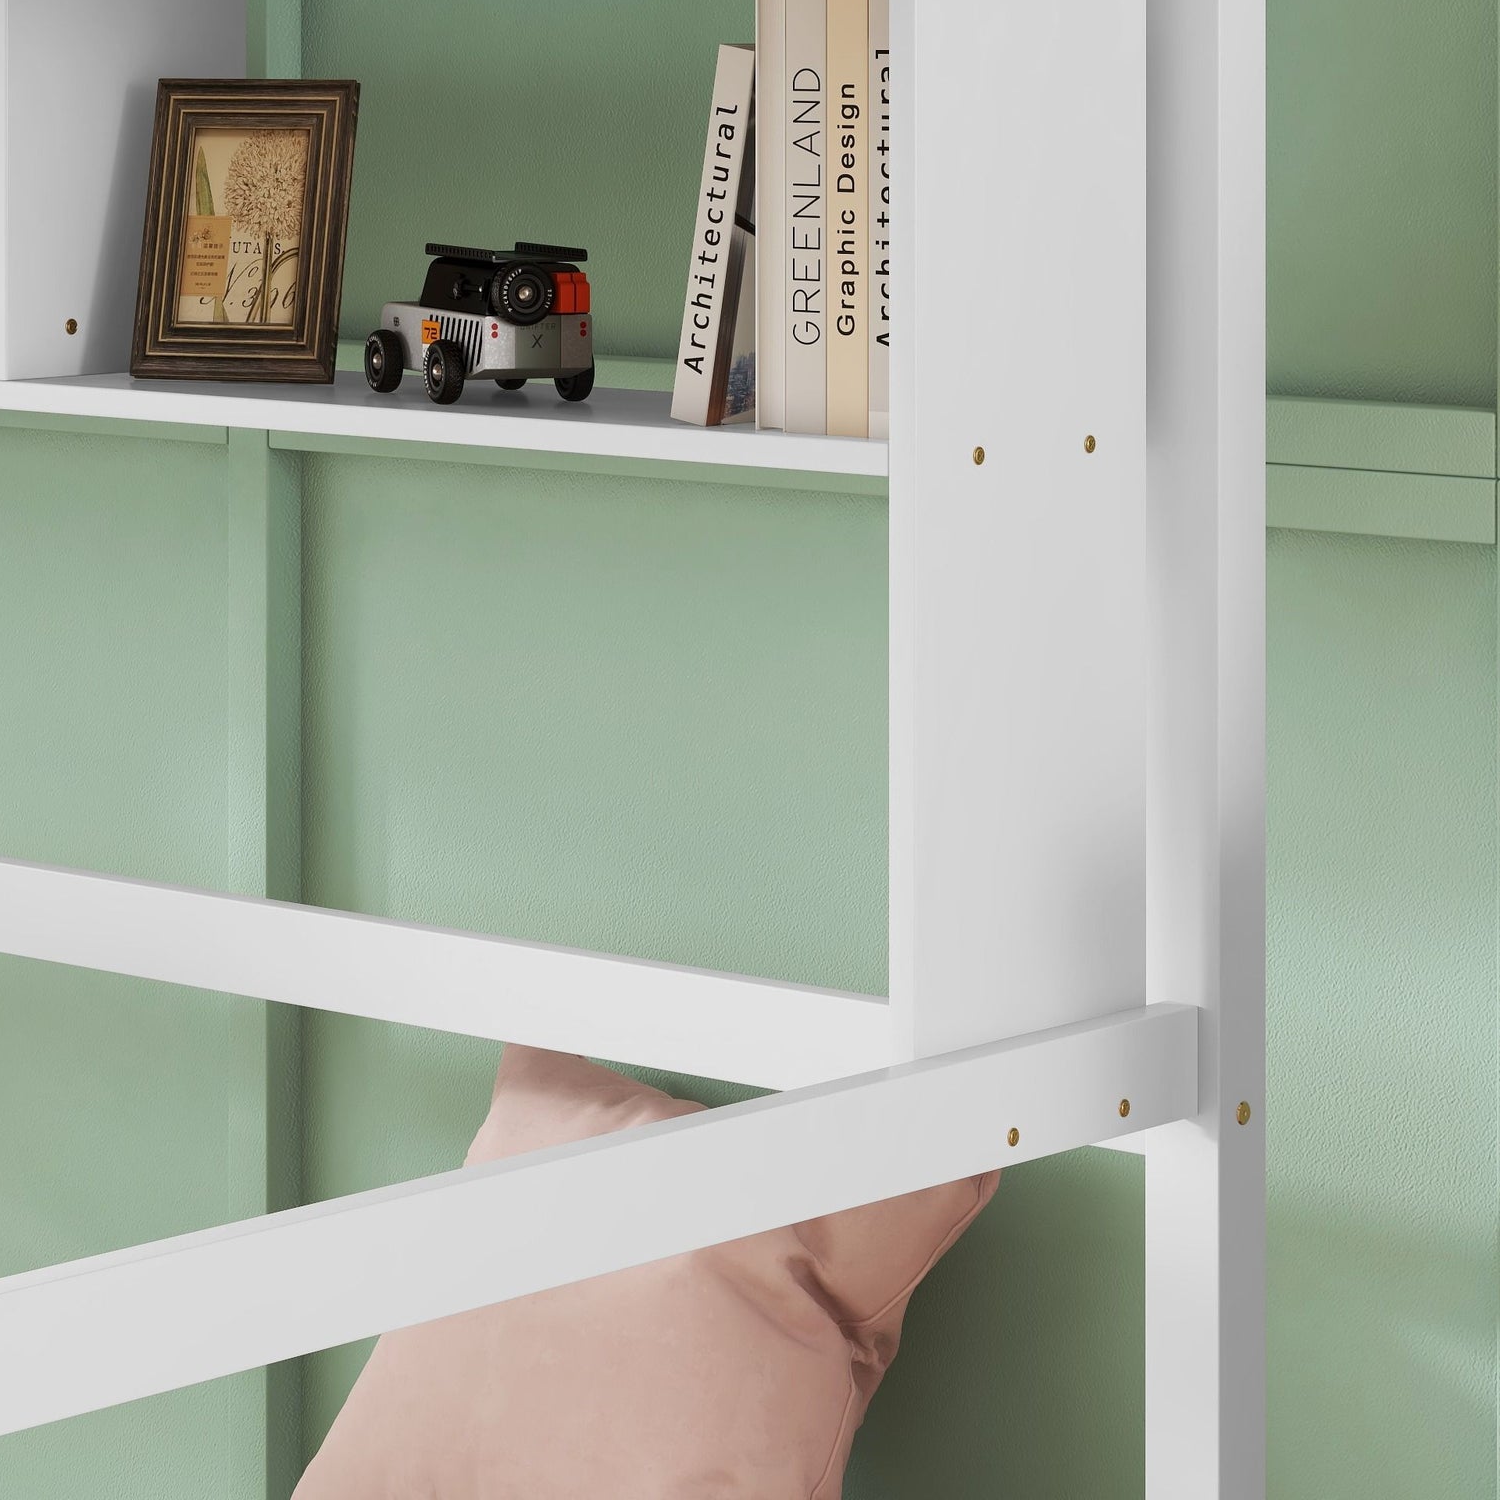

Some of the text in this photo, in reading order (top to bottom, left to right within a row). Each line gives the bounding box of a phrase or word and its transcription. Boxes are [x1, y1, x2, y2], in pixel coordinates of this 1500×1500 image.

[424, 327, 438, 340] 72
[682, 103, 739, 375] Architectural
[792, 67, 821, 347] GREENLAND
[836, 82, 860, 338] Graphic Design
[531, 333, 544, 348] X
